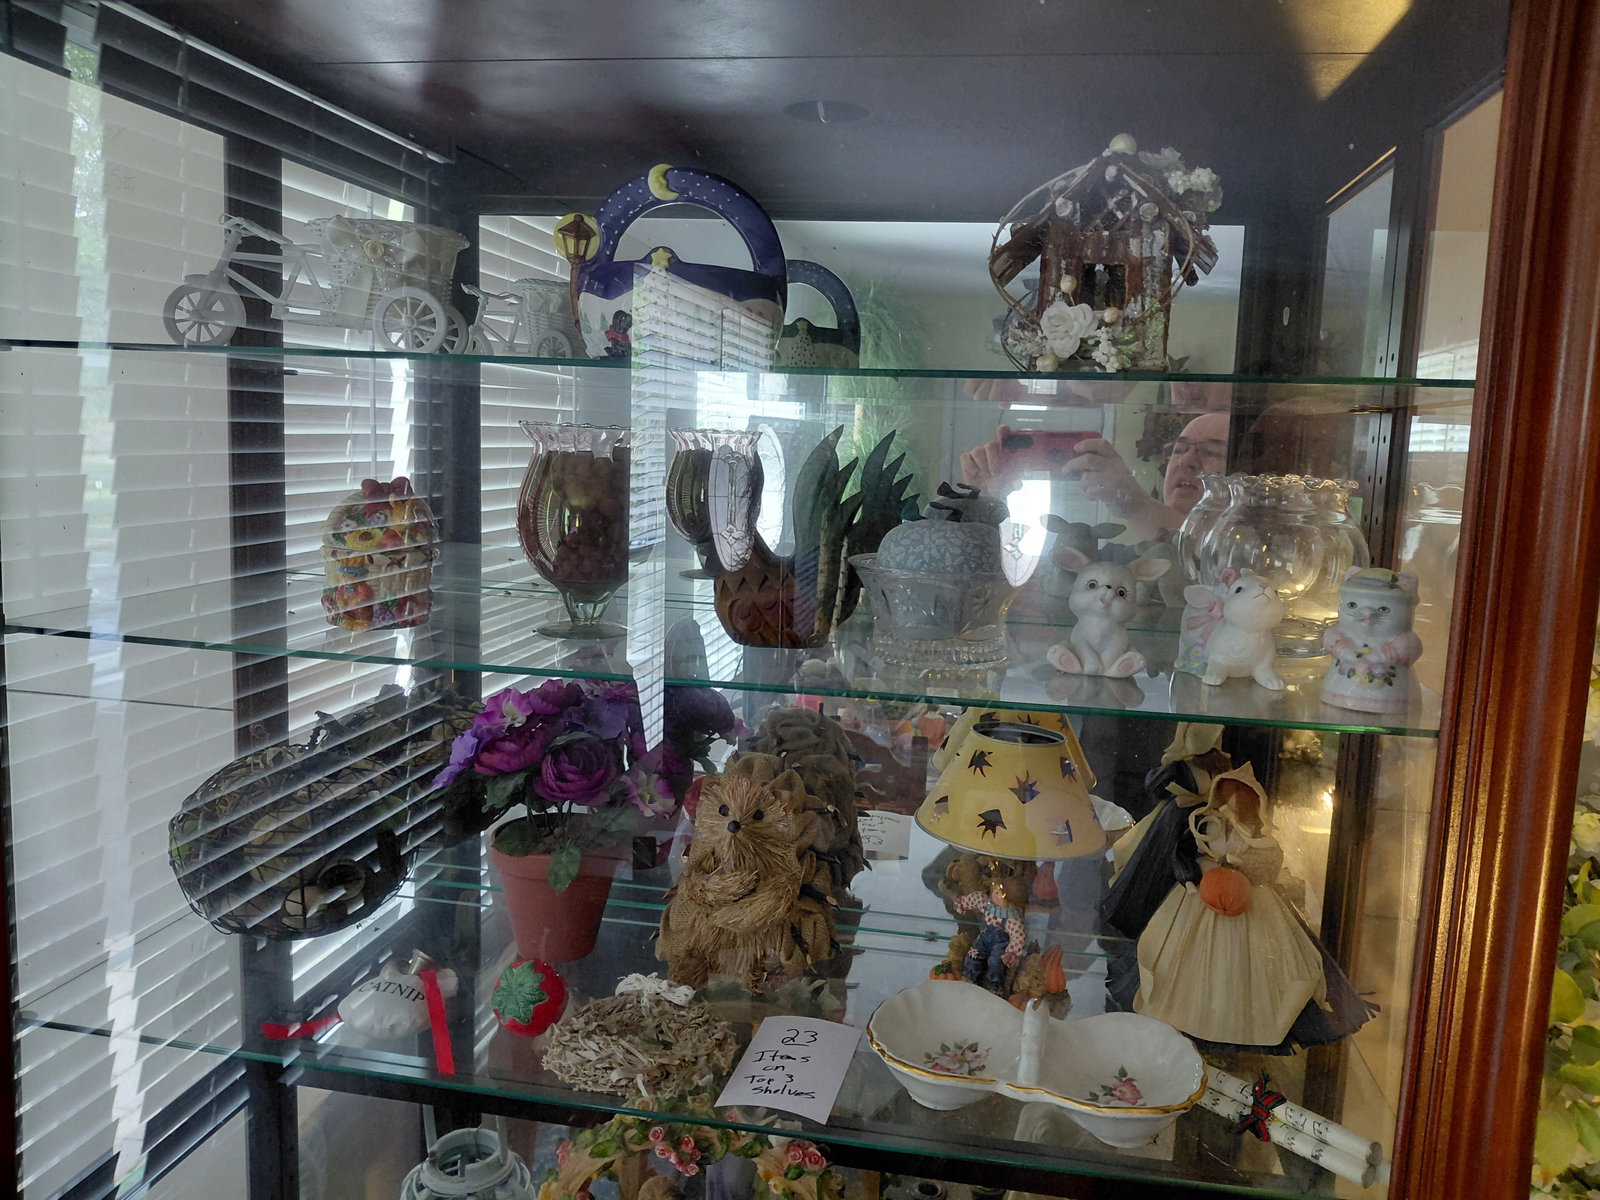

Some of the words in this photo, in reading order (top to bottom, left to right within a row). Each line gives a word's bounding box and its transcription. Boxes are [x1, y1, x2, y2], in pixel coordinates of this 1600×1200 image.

[358, 981, 425, 1002] CATNIP
[781, 1028, 818, 1045] 23
[752, 1049, 812, 1063] Items
[744, 1074, 775, 1085] Top
[785, 1073, 794, 1084] 3
